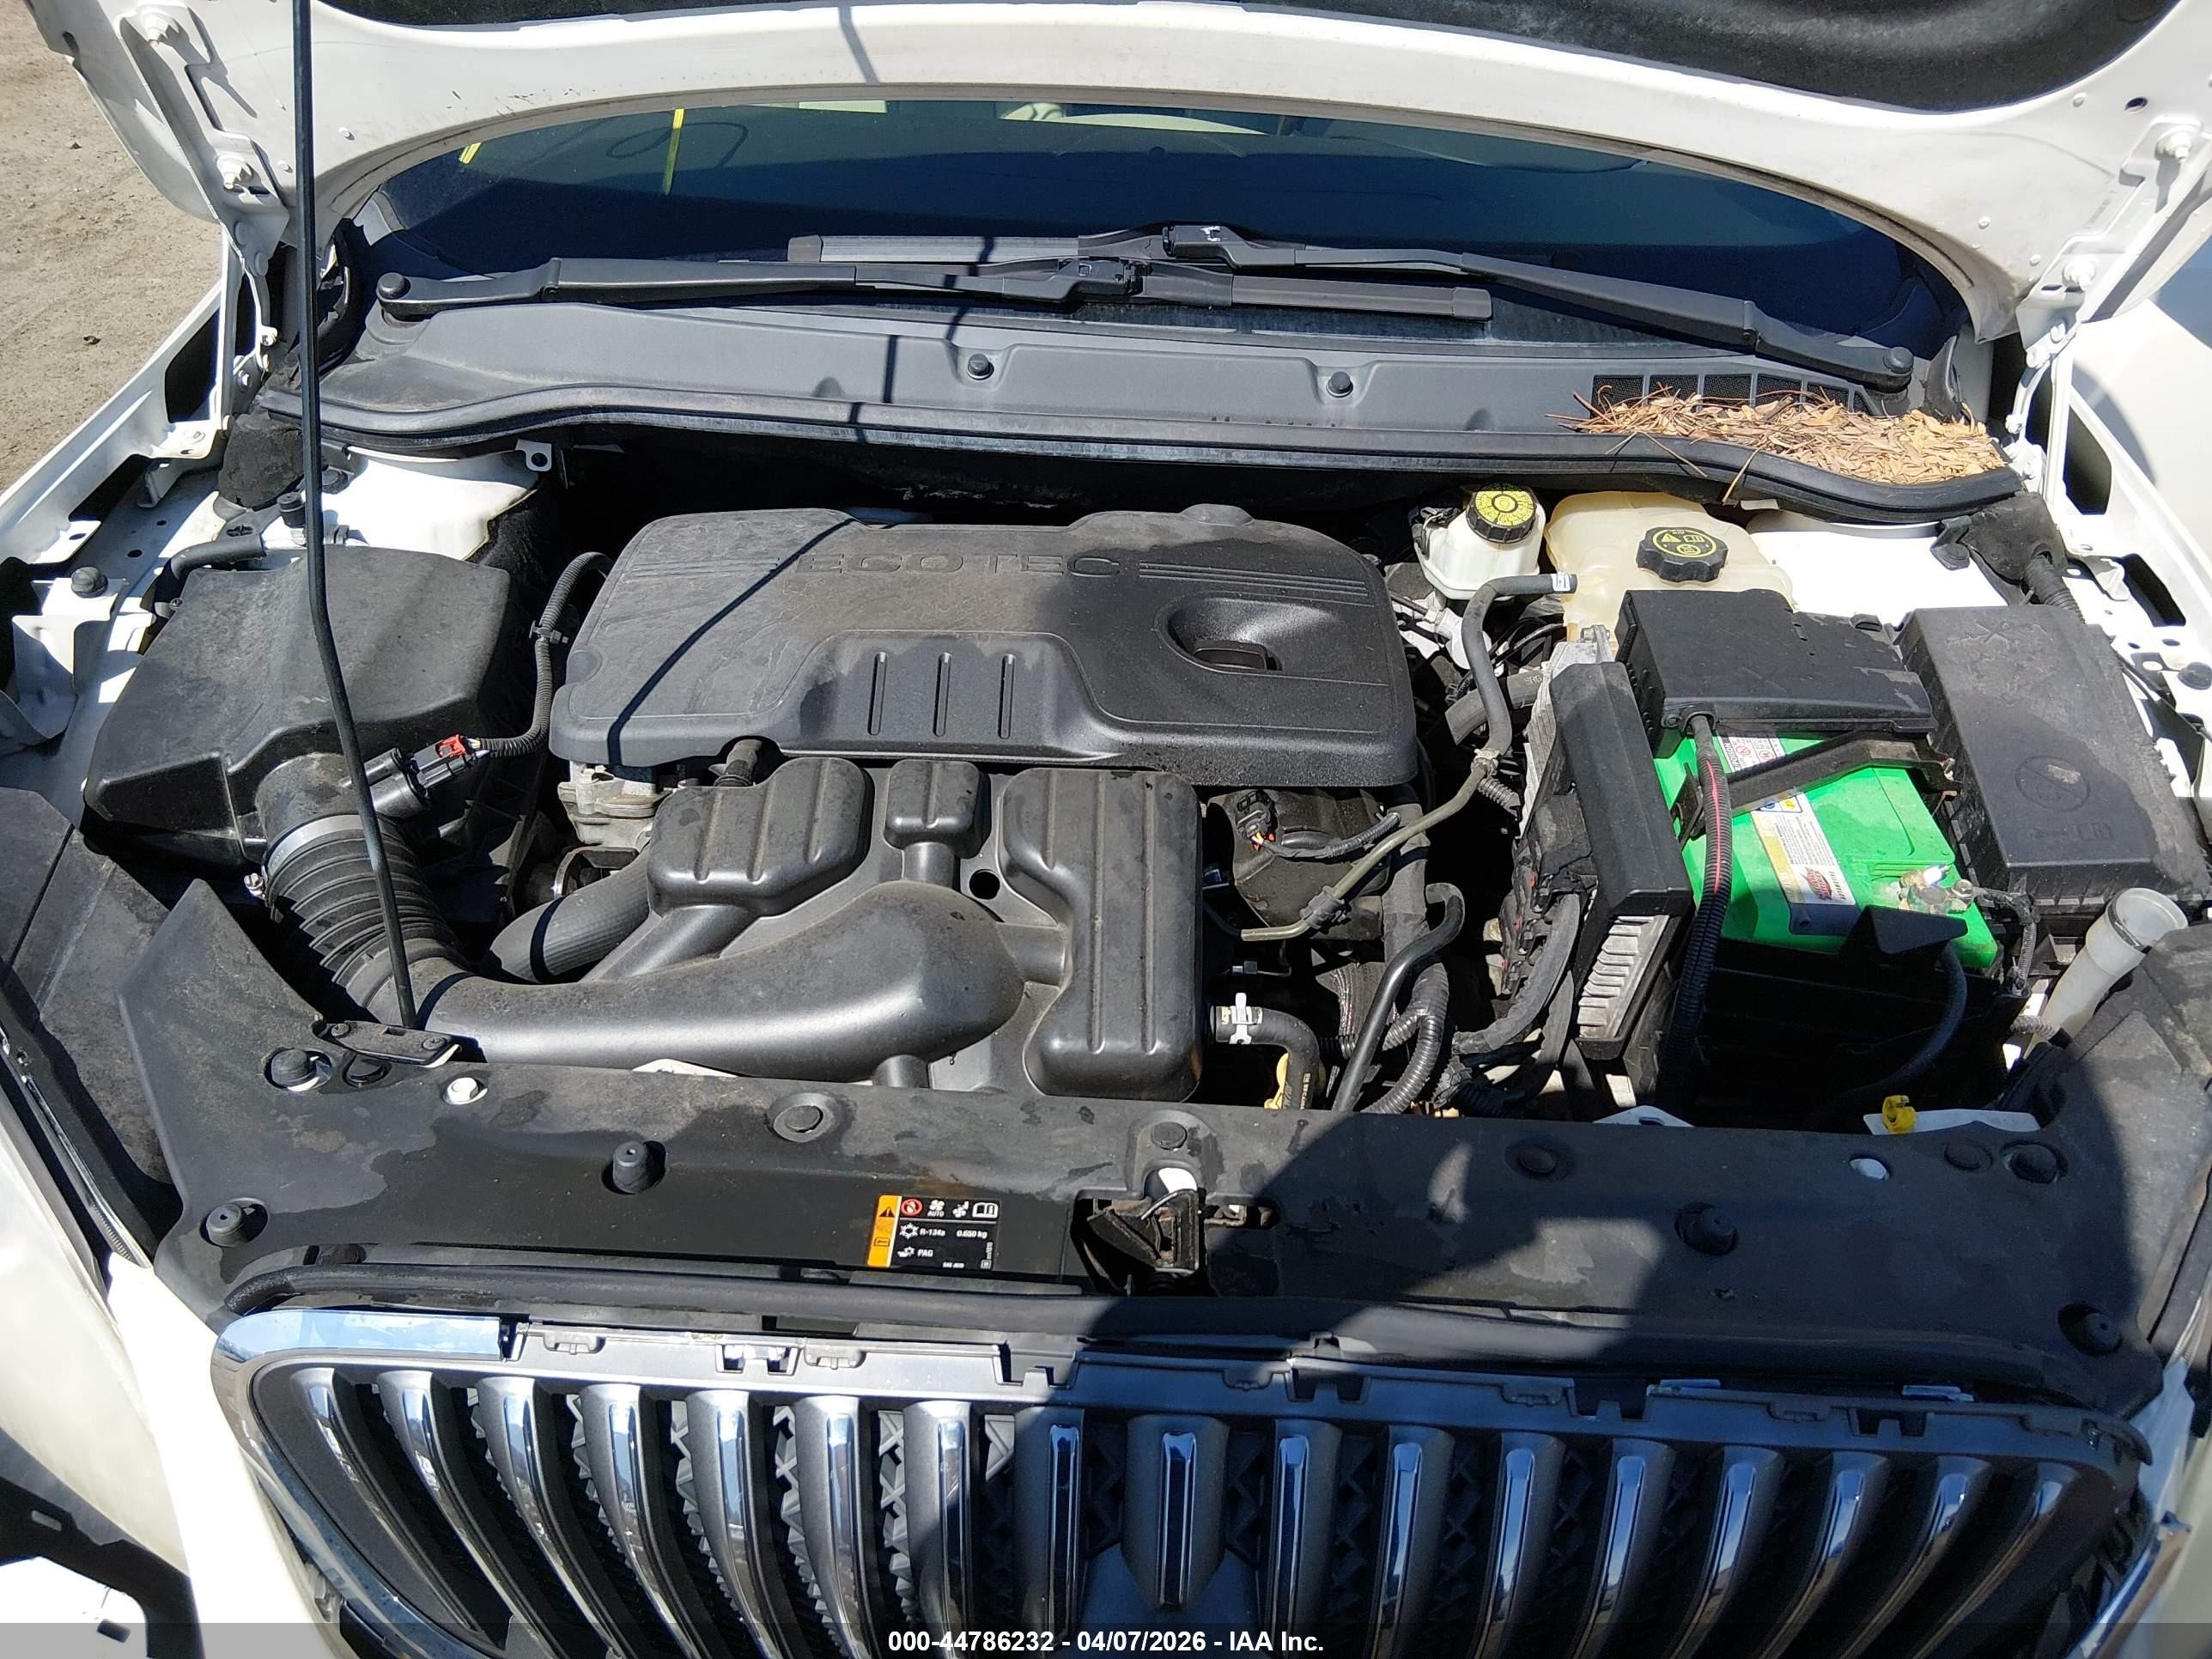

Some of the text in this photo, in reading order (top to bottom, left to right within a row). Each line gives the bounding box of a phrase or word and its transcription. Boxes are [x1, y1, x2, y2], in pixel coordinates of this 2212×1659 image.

[795, 553, 1120, 578] ECOTEC
[920, 1228, 946, 1237] R-134a
[977, 1231, 988, 1239] kg
[917, 1249, 933, 1257] PAG
